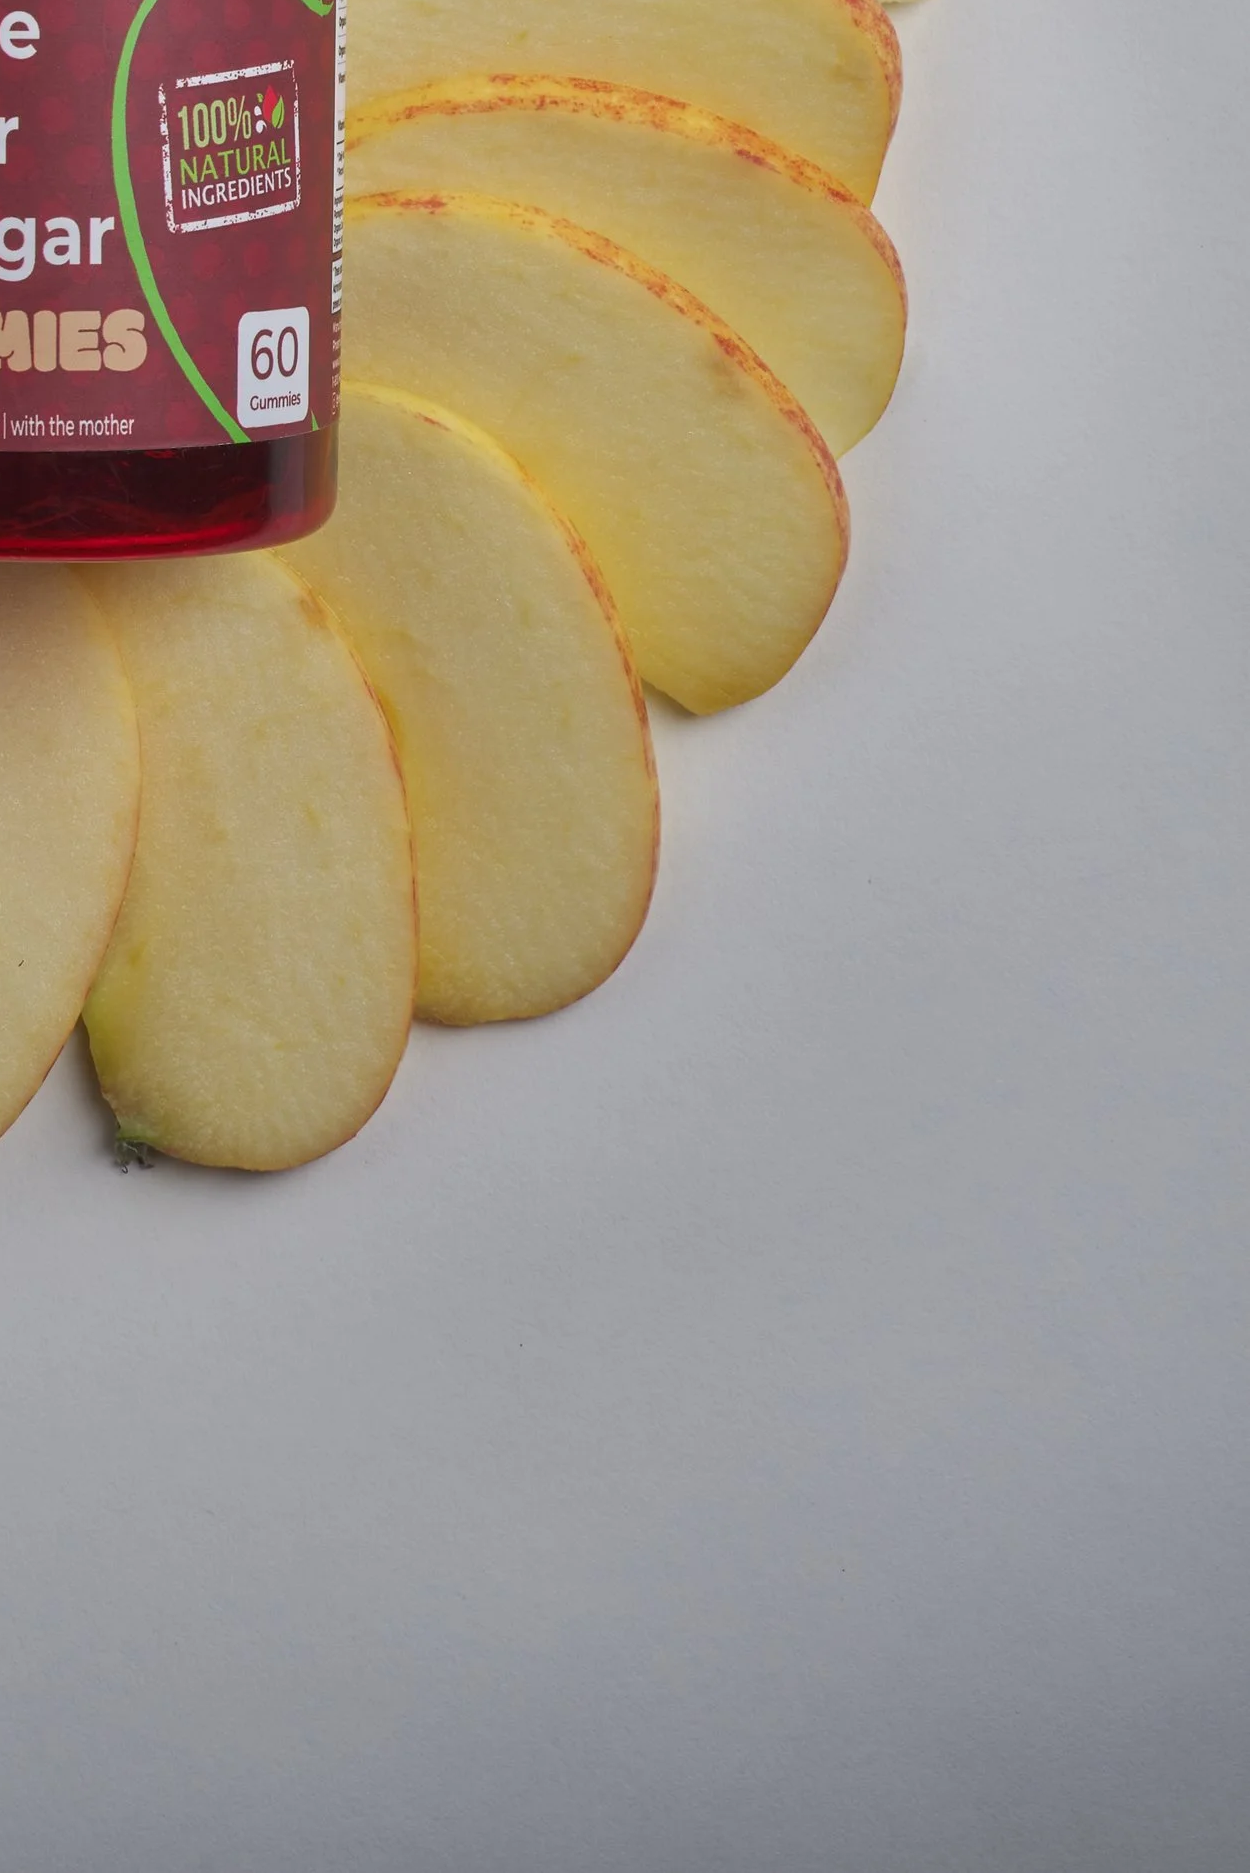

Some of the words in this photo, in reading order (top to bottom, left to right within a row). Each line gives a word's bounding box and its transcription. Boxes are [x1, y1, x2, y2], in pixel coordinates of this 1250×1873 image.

[177, 95, 252, 151] 100%
[179, 137, 291, 186] NATURAL
[181, 167, 292, 210] INGREDIENTS
[251, 326, 299, 381] 60
[250, 391, 301, 411] Gummies
[10, 414, 45, 437] with
[49, 416, 75, 437] the
[78, 414, 135, 437] mother
